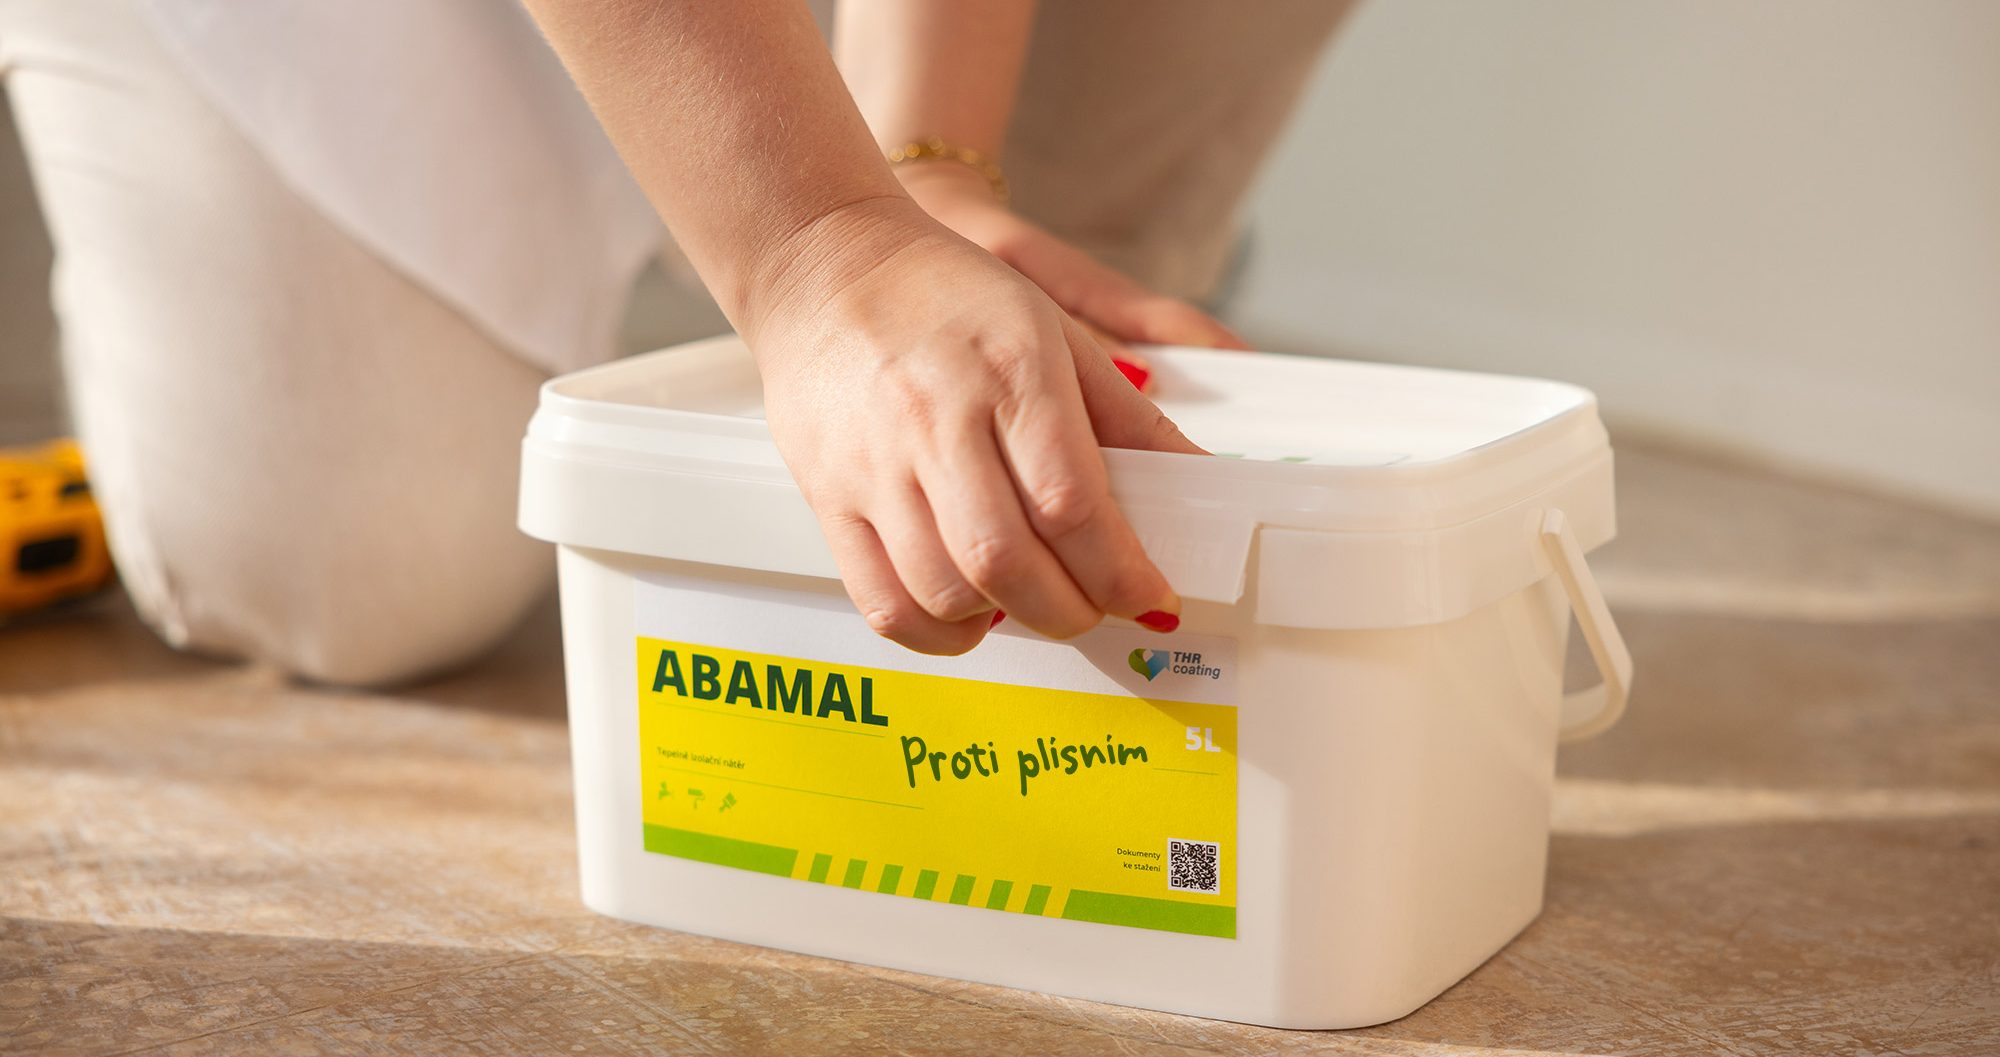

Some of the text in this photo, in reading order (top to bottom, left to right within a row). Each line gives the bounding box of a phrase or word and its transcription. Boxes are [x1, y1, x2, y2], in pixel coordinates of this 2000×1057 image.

[1173, 651, 1202, 664] THR
[1173, 664, 1221, 680] coating
[652, 649, 888, 727] ABAMAL
[1185, 726, 1221, 753] 5L
[901, 734, 1148, 796] Proti plísním
[1116, 847, 1161, 861] Dokumenty
[1123, 861, 1161, 872] ke stažení
